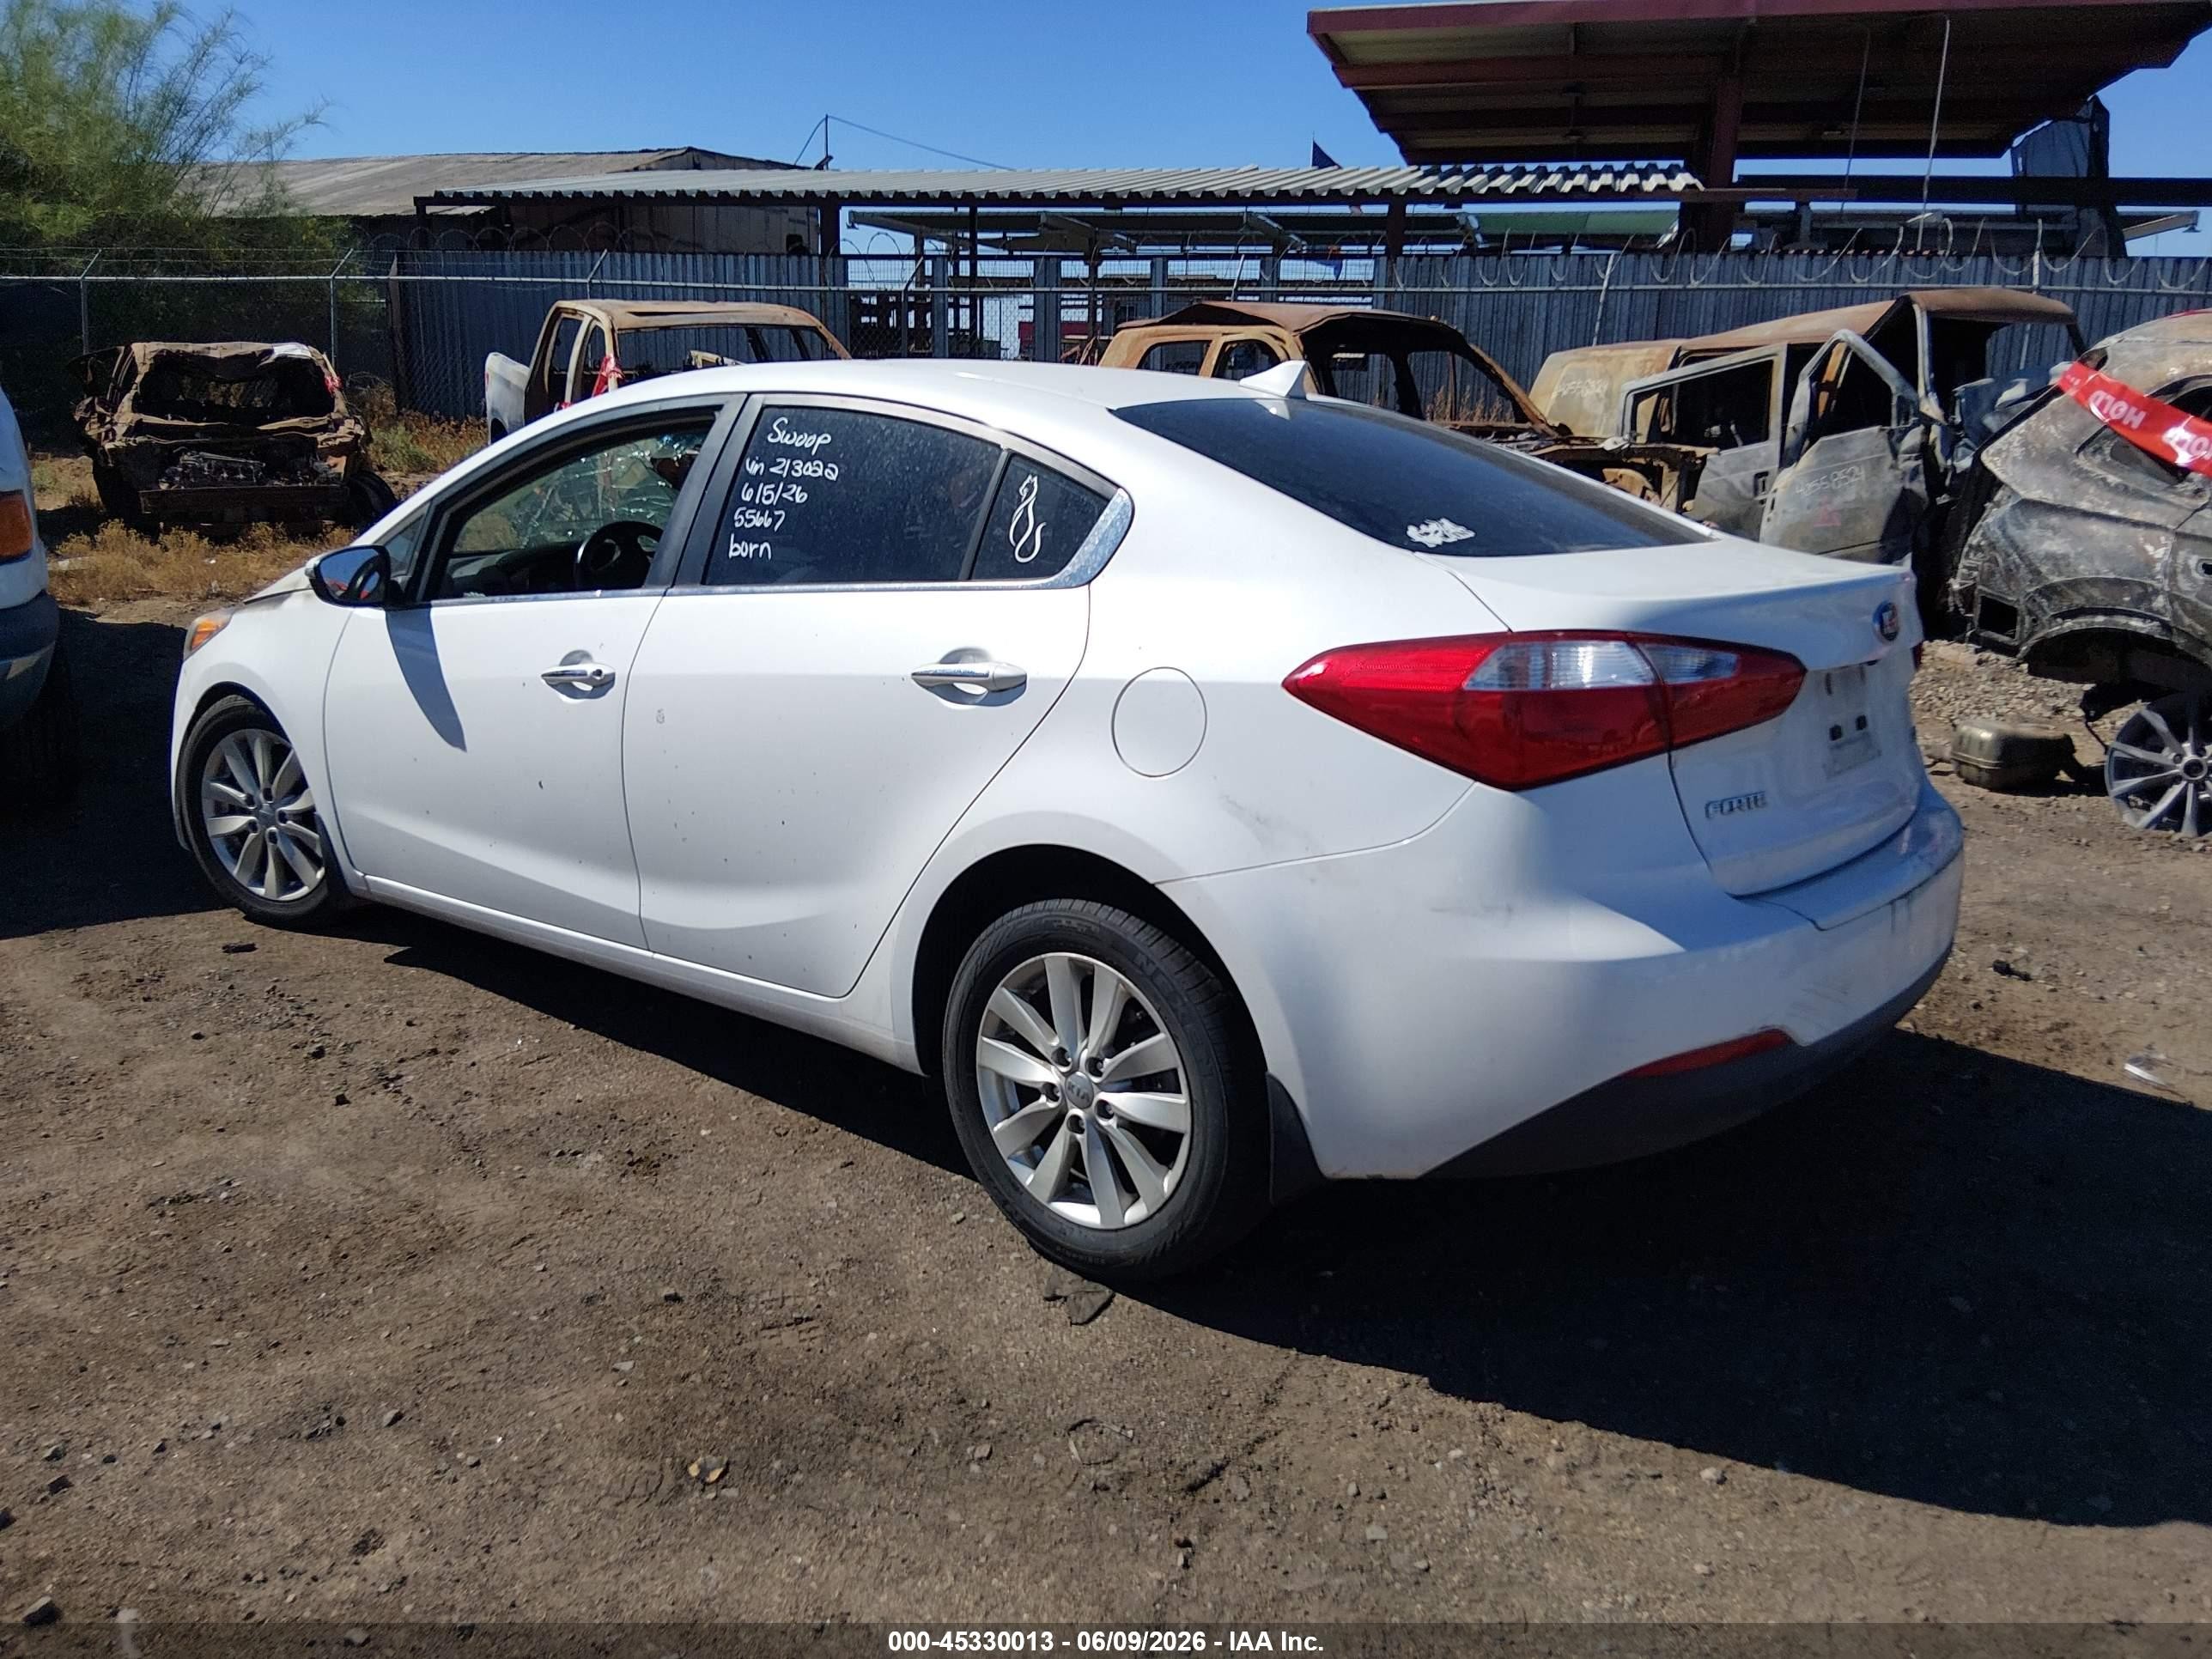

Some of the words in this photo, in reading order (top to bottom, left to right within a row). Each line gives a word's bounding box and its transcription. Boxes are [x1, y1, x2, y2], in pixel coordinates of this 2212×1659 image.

[767, 417, 832, 456] Swoop
[745, 456, 765, 476] vin
[741, 482, 809, 506] 6/5/26
[734, 507, 786, 532] 55667
